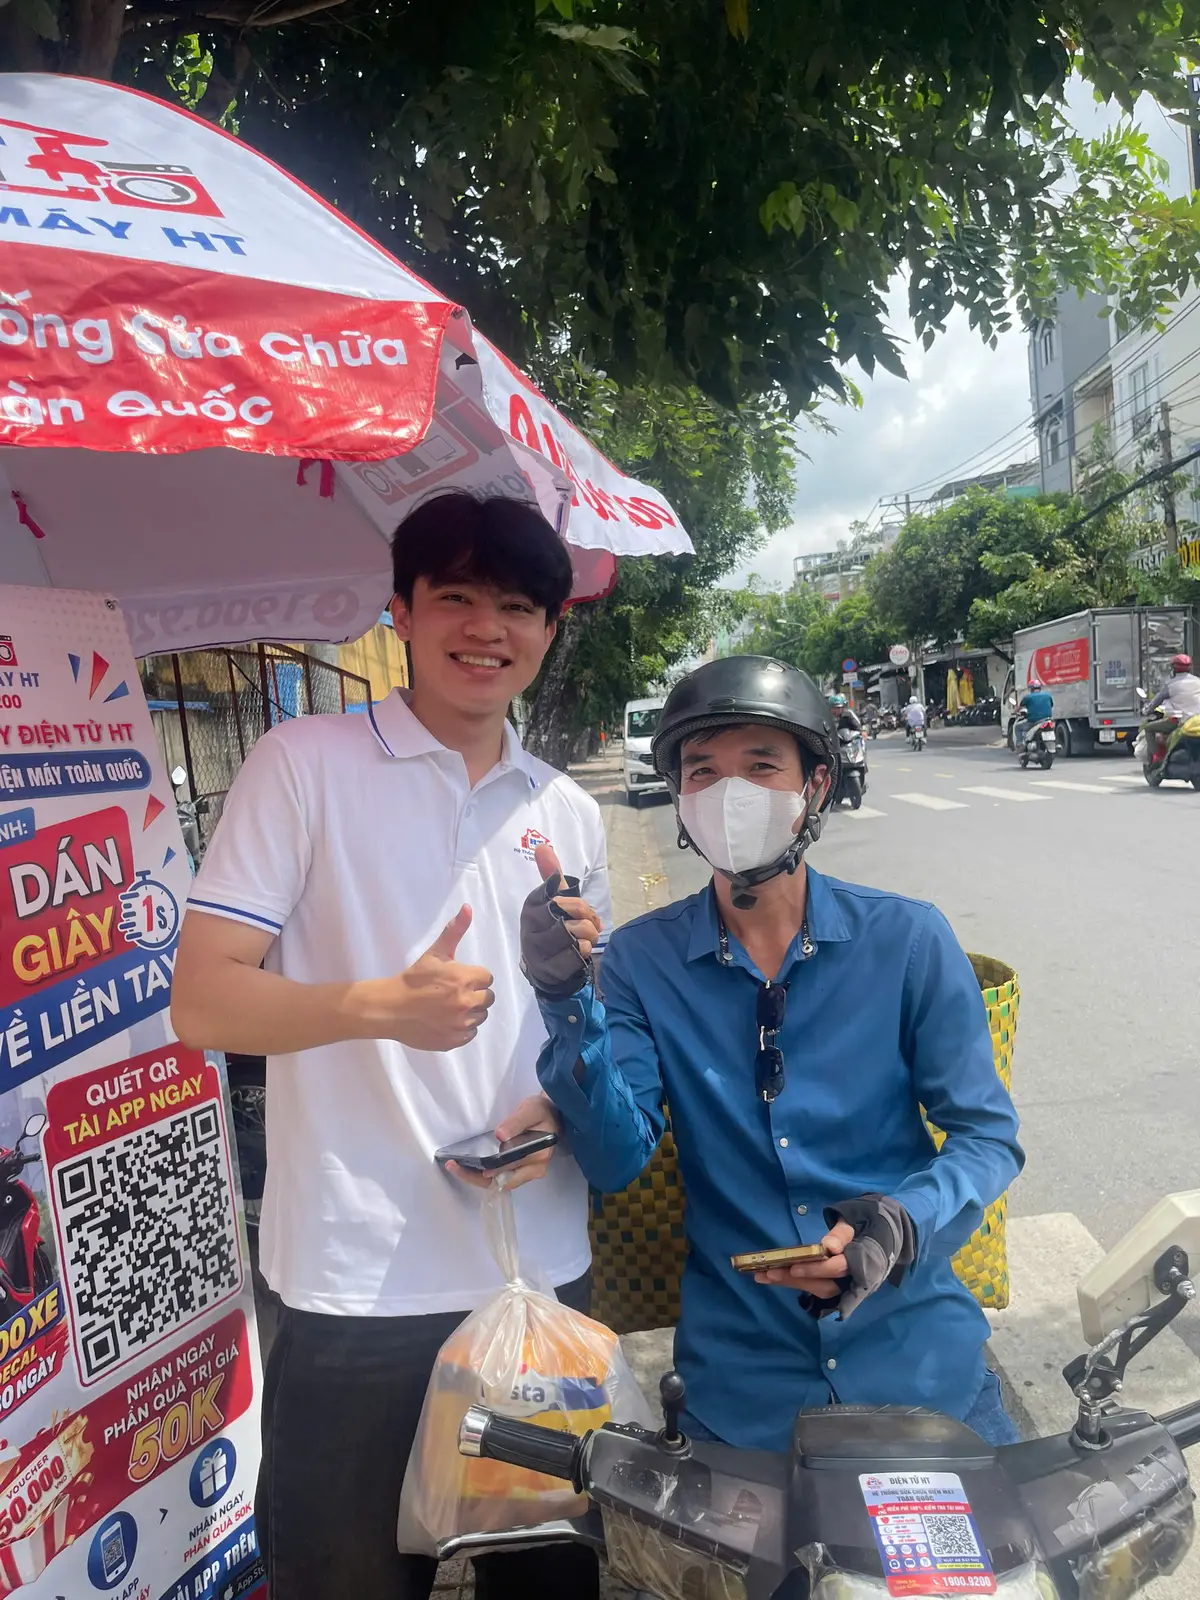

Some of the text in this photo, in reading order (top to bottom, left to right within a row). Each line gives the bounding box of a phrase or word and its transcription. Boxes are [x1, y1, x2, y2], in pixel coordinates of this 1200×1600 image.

[161, 226, 247, 256] HT
[131, 306, 242, 360] Sửa
[259, 331, 408, 368] Chữa
[107, 383, 274, 426] Quốc
[20, 672, 39, 688] HT
[17, 719, 71, 749] ĐIỆN
[73, 719, 102, 743] TỬ
[108, 723, 133, 741] HT
[27, 762, 62, 787] MÁY
[65, 760, 104, 784] TOÀN
[106, 757, 143, 782] QUỐC
[8, 836, 124, 919] DÁN
[12, 906, 114, 983] GIÂY
[39, 978, 121, 1051] LIỀN
[86, 1057, 180, 1107] QUÉT QR
[63, 1074, 203, 1146] TẢI APP NGAY
[28, 1287, 58, 1339] XE
[16, 1350, 57, 1400] NGÀY
[104, 1338, 239, 1445] PHẦN QUÀ TRỊ GIÁ
[127, 1333, 216, 1404] NHẬN NGAY
[128, 1372, 225, 1483] 50K
[6, 1454, 49, 1500] VOUCHER
[54, 1475, 68, 1490] VND
[189, 1490, 244, 1542] NHẬN NGAY
[212, 1516, 233, 1539] QUÀ
[235, 1501, 252, 1522] 50K
[194, 1560, 220, 1598] APP
[224, 1530, 256, 1571] TRÊN
[942, 1576, 992, 1587] 1900.9200
